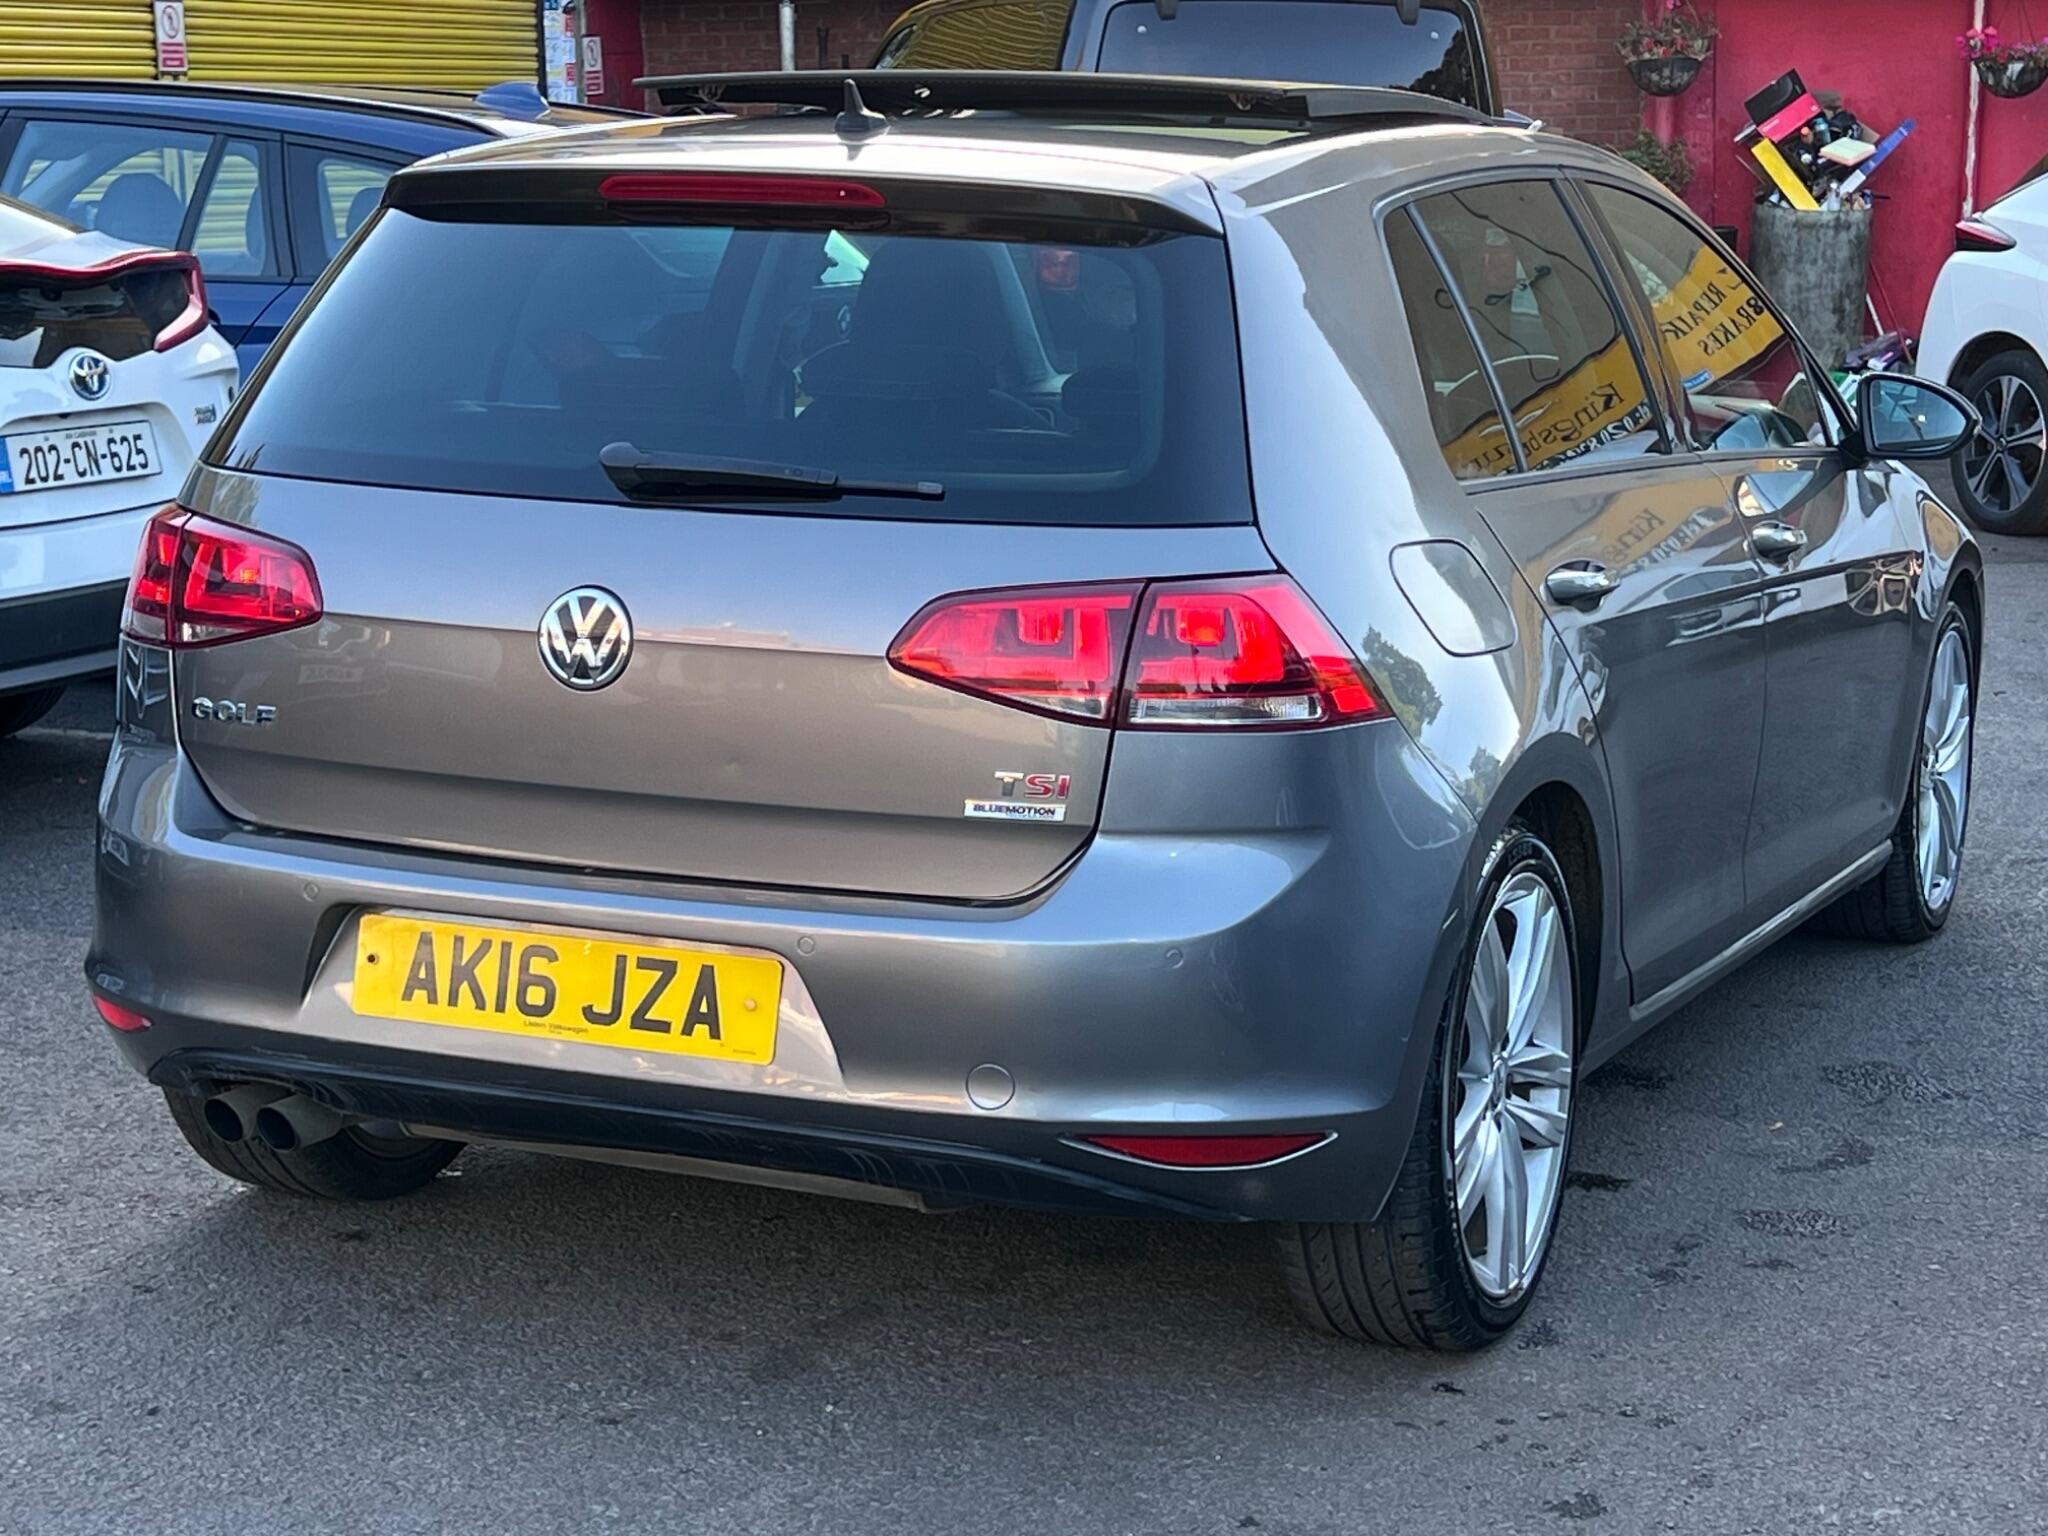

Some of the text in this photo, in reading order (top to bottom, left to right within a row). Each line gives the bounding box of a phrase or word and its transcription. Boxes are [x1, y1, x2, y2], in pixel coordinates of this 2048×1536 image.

[20, 434, 149, 485] 202-CN-625
[192, 696, 277, 725] GOLF
[994, 770, 1071, 799] TSI
[973, 803, 1056, 816] BLUEMOTION
[401, 931, 722, 1041] AK16 JZA
